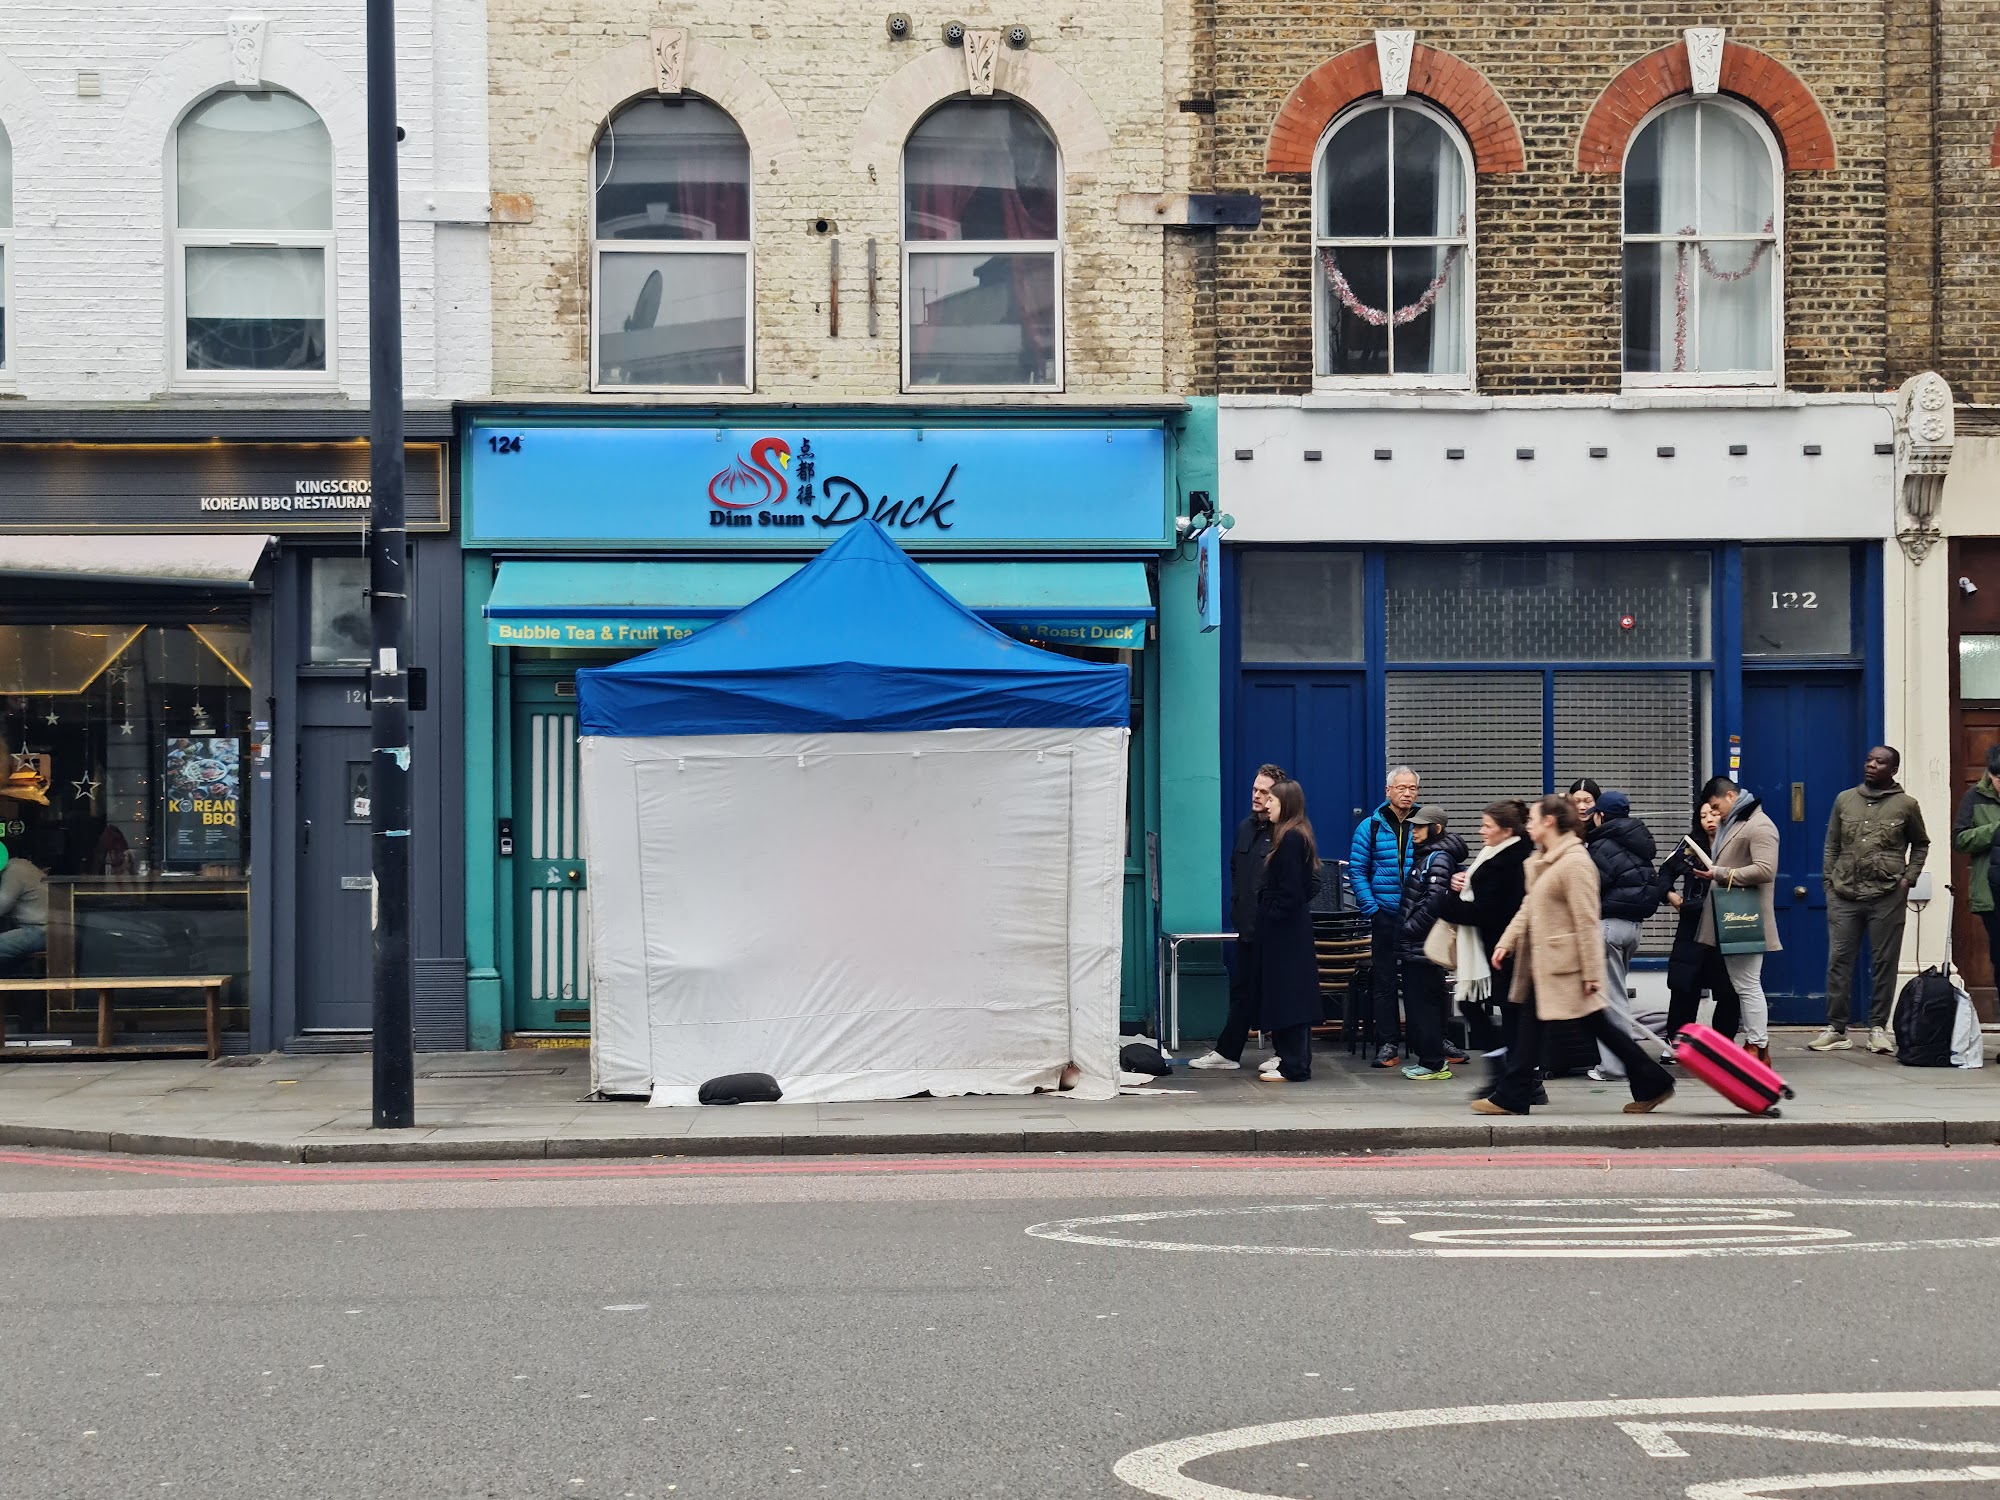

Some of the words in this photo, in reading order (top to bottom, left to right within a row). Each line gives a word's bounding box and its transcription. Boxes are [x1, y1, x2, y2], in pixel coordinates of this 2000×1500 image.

[489, 436, 521, 454] 124
[796, 437, 816, 507] 点都得
[201, 497, 259, 510] KOREAN
[261, 497, 292, 511] BBQ
[709, 510, 752, 527] Dim
[758, 510, 805, 527] Sum
[811, 463, 958, 529] Duck
[1771, 591, 1818, 609] 122
[499, 625, 561, 640] Bubble
[565, 625, 595, 640] Tea
[601, 625, 614, 640] &
[619, 625, 658, 640] Fruit
[663, 625, 693, 640] Tea
[1037, 625, 1086, 638] Roast
[1091, 626, 1133, 639] Duck
[202, 812, 236, 827] BBQ
